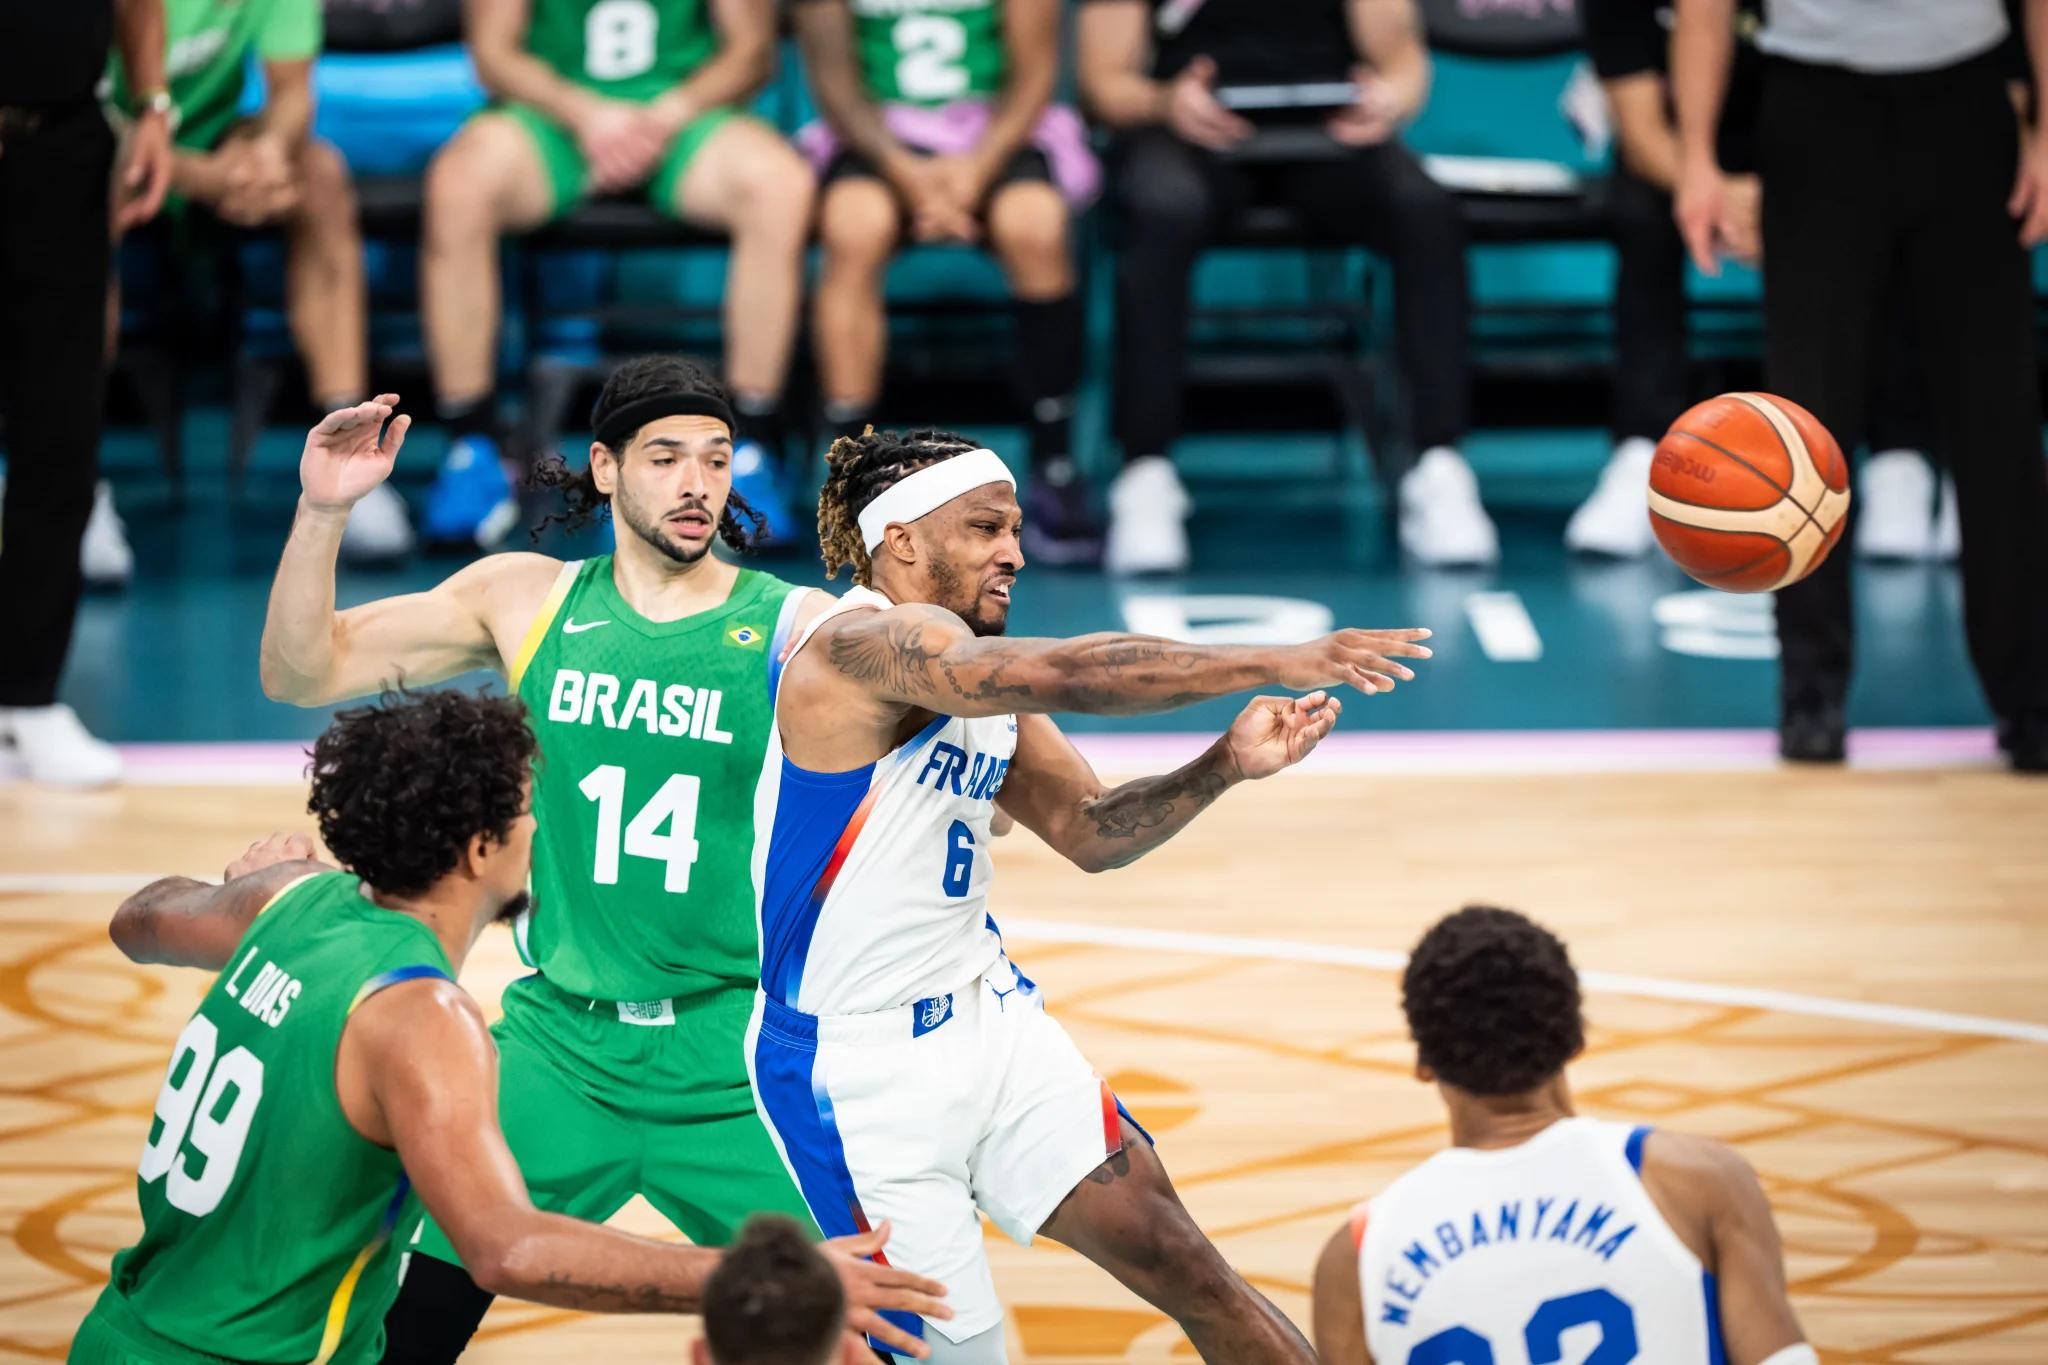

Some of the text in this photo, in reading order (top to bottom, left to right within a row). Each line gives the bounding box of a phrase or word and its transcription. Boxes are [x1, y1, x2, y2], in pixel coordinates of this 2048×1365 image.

[584, 0, 659, 81] 8
[891, 14, 971, 99] 2
[548, 668, 734, 745] BRASIL
[916, 740, 1010, 801] FRANC
[578, 764, 701, 894] 14
[942, 818, 976, 898] 6
[239, 960, 302, 1029] DIAS
[137, 1012, 264, 1218] 99
[1379, 1196, 1638, 1326] WEMBANYAMA
